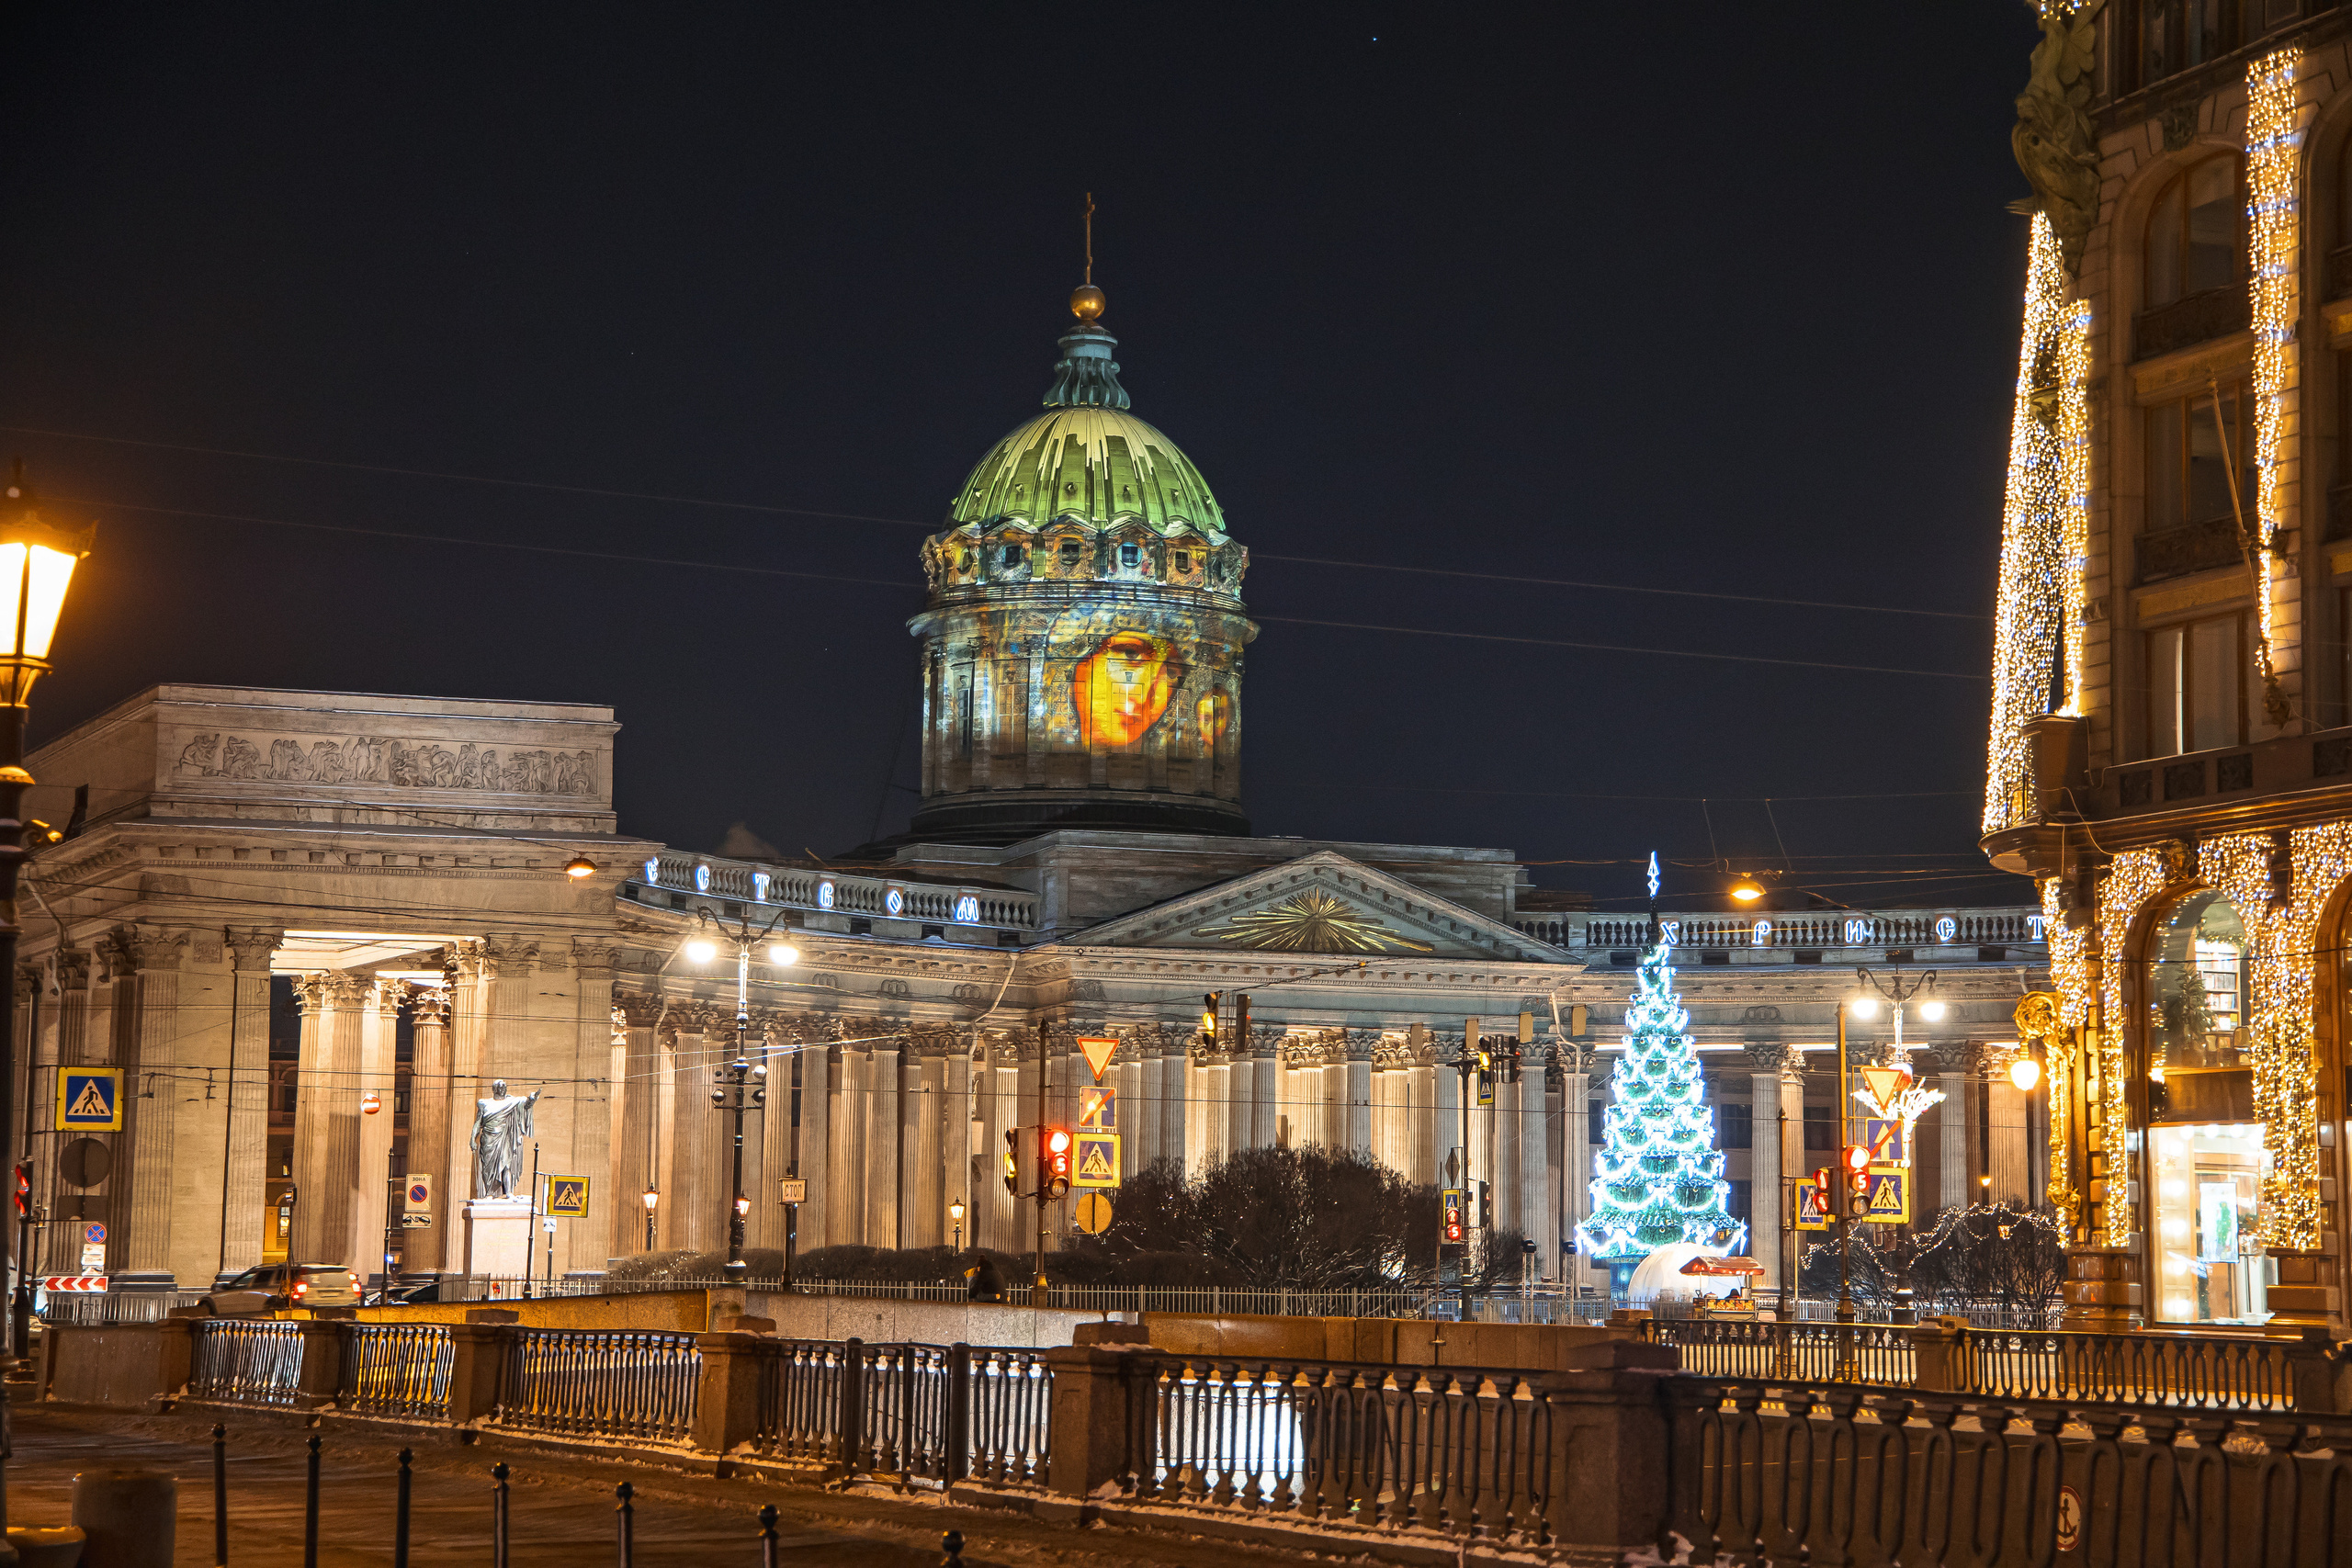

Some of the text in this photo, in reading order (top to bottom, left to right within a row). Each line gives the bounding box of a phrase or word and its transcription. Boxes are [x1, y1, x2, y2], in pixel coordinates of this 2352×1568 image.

[1659, 917, 2046, 943] ХРИСТ
[1057, 1157, 1066, 1171] 5
[1858, 1175, 1866, 1190] 5
[785, 1183, 803, 1198] СТОП
[1452, 1227, 1459, 1237] 5
